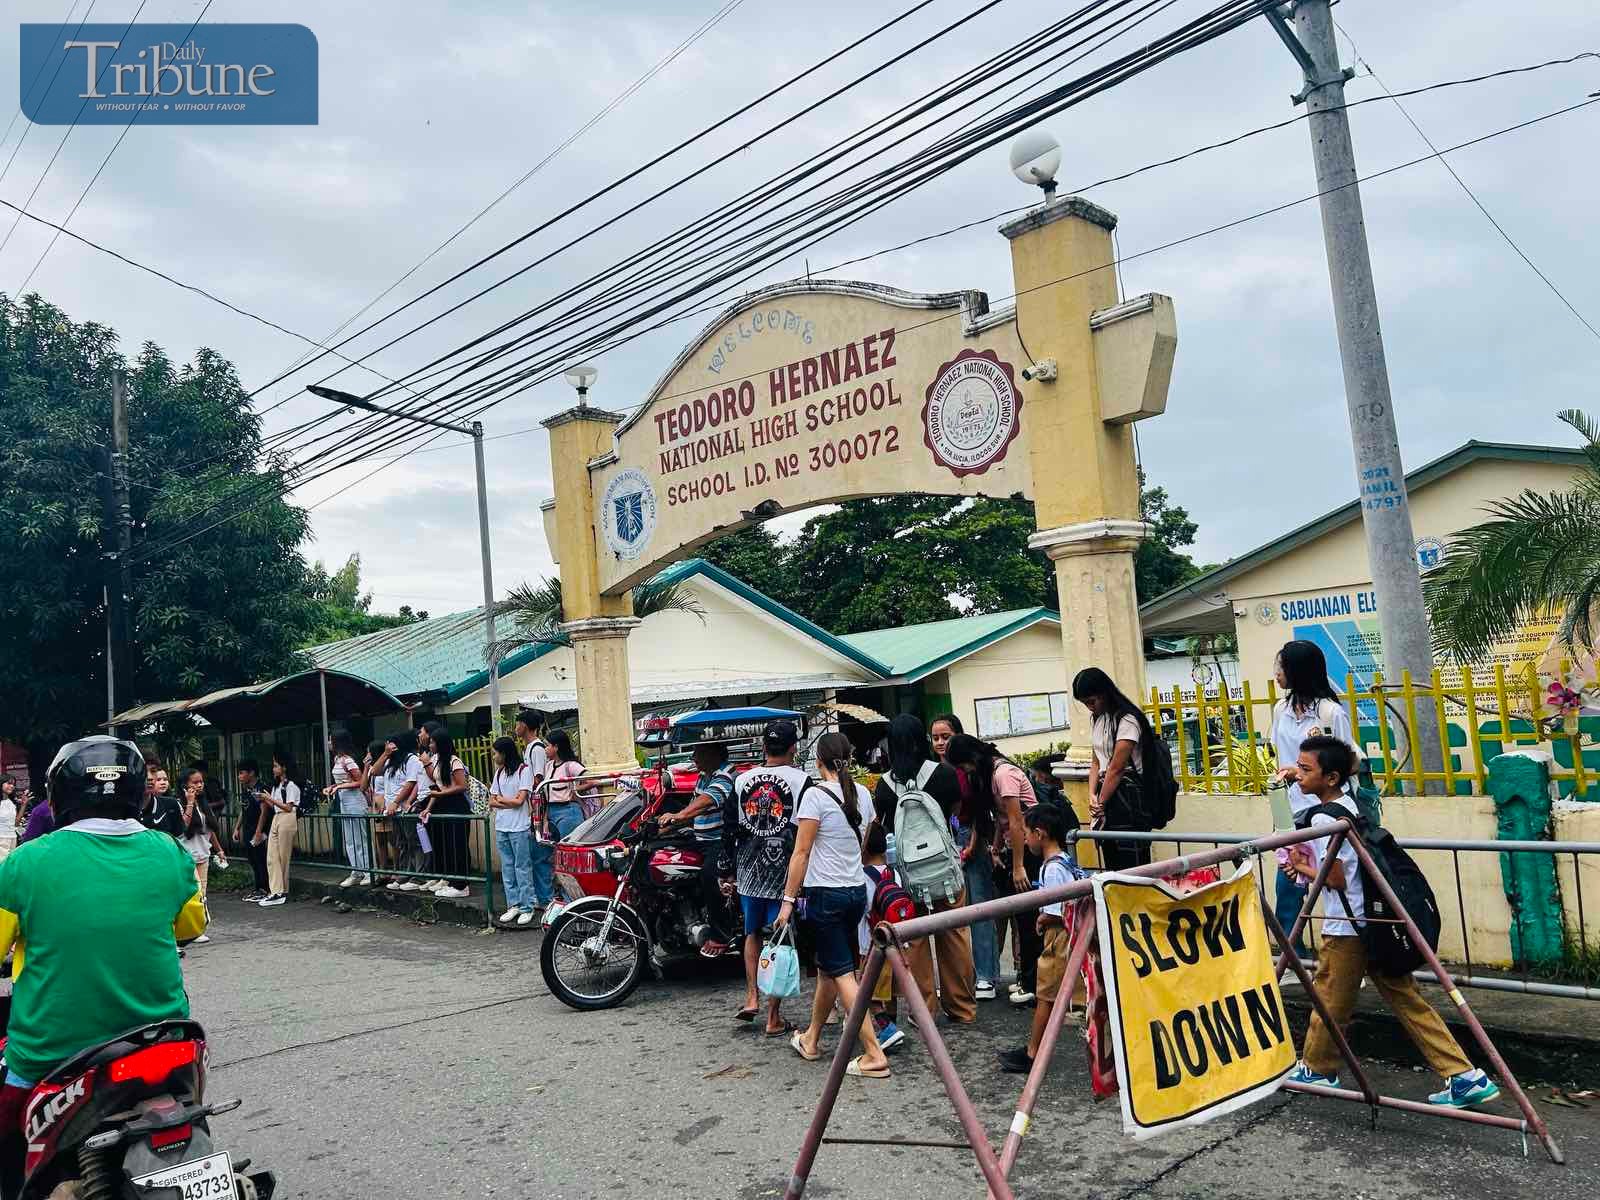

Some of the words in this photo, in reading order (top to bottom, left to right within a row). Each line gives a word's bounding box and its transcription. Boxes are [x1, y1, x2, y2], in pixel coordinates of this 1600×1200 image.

[708, 309, 816, 375] WELCOME
[654, 380, 756, 445] TEODORO
[769, 327, 897, 407] HERNAEZ
[934, 366, 963, 402] HERNAEZ
[964, 362, 997, 382] NATIONAL
[993, 374, 1008, 395] HIGH
[659, 427, 746, 475] NATIONAL
[750, 409, 800, 448] HIGH
[805, 378, 903, 432] SCHOOL
[930, 405, 943, 444] TEODORO
[1000, 393, 1011, 428] SCHOOL
[667, 471, 736, 506] SCHOOL
[744, 462, 771, 487] I.D.
[808, 425, 900, 472] 300072
[1280, 594, 1351, 621] SABUANAN
[1119, 894, 1247, 979] SLOW
[1150, 983, 1285, 1090] DOWN
[25, 1077, 85, 1143] CLICK
[185, 1174, 230, 1200] 43733
